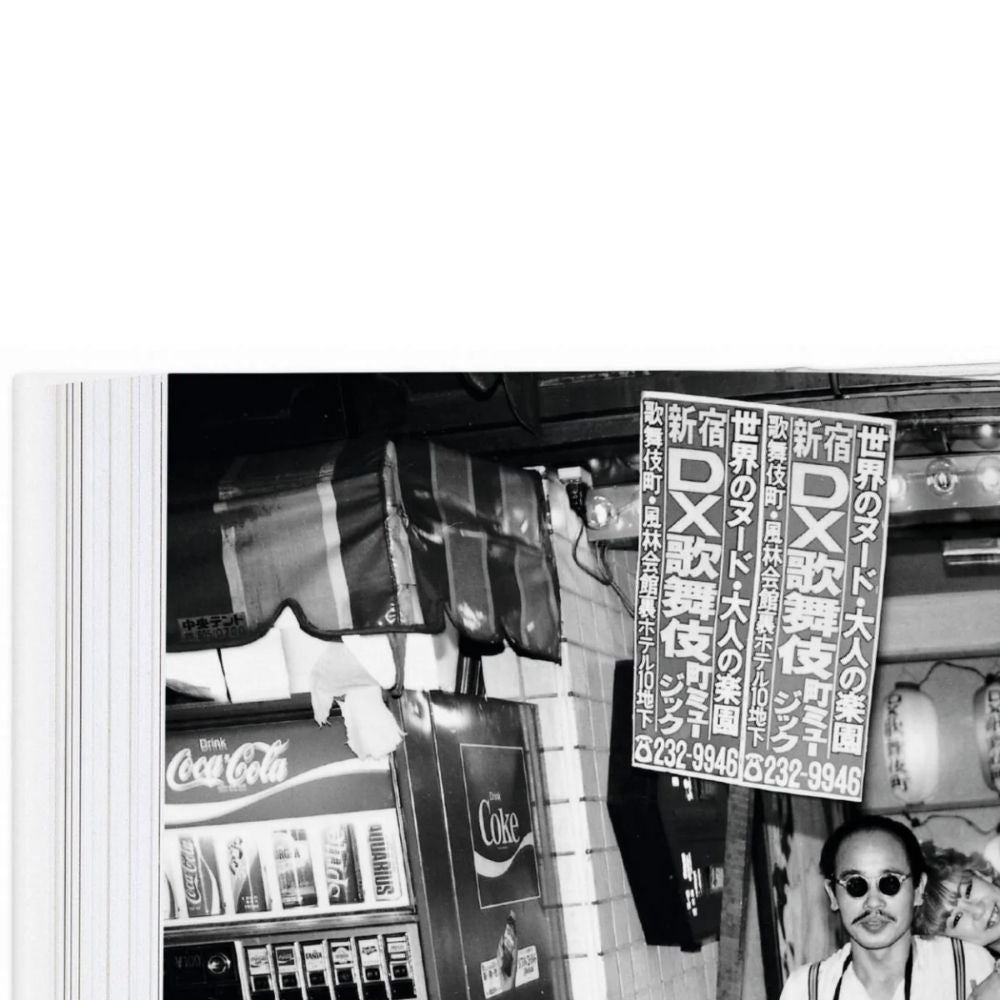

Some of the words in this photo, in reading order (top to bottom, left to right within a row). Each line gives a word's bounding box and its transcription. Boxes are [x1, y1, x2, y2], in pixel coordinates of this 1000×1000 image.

[668, 403, 727, 448] 新宿
[793, 418, 854, 463] 新宿
[199, 738, 228, 751] Drink
[653, 737, 739, 778] 232-9946
[764, 754, 862, 797] 232-9946
[478, 799, 520, 846] Coke
